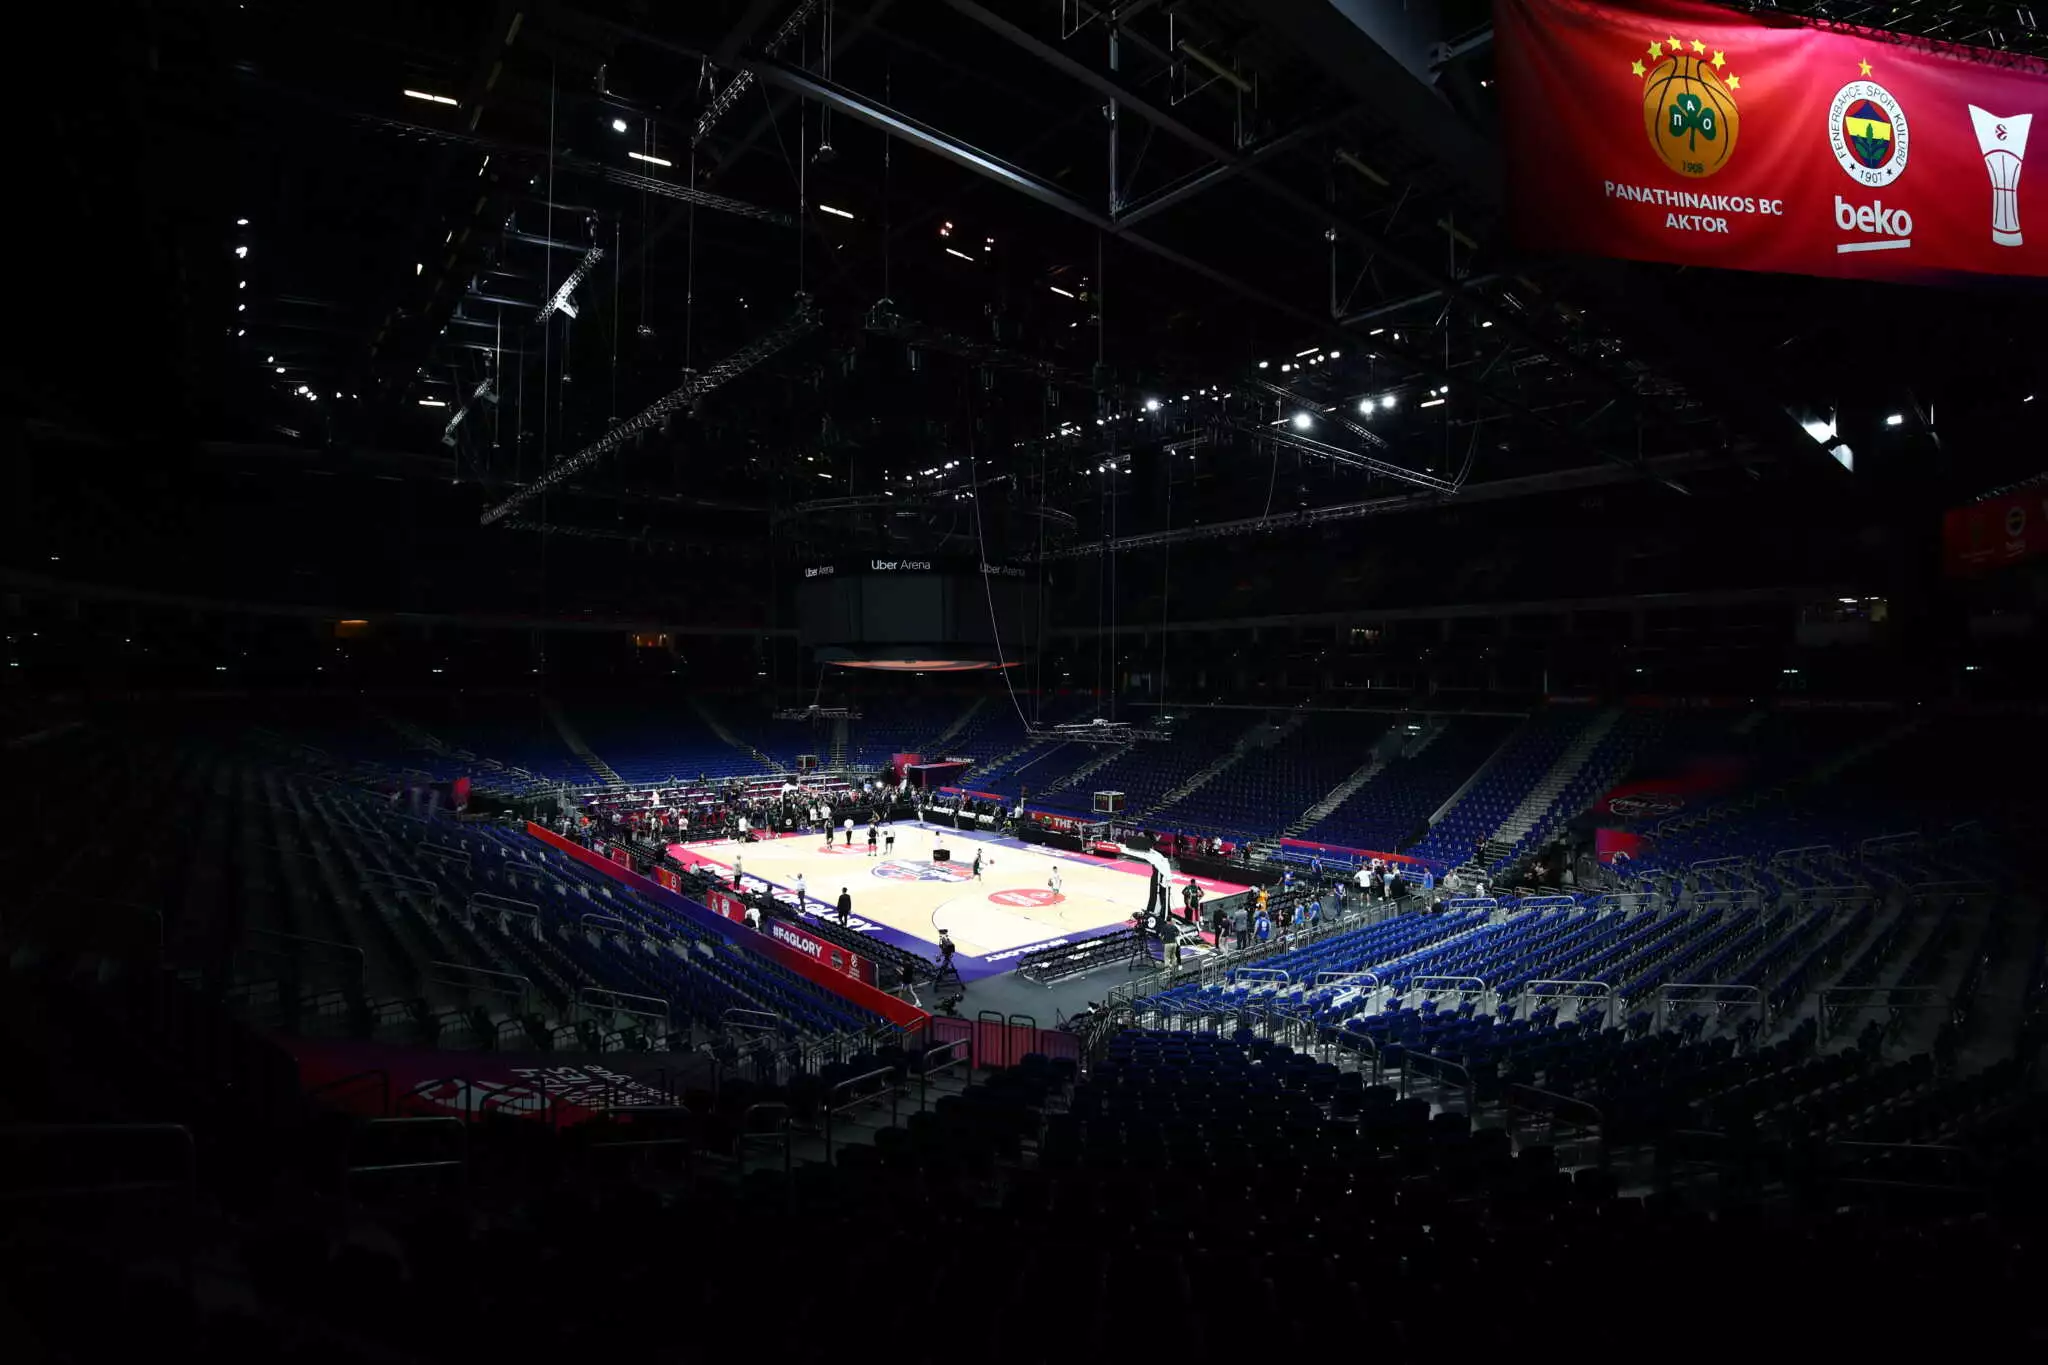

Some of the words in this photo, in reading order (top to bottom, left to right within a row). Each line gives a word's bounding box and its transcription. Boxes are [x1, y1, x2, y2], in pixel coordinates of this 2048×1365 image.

[1866, 85, 1895, 112] SPOR
[1860, 169, 1882, 184] 1907
[1604, 180, 1755, 213] PANATHINAIKOS
[1759, 198, 1783, 215] BC
[1666, 212, 1729, 233] AKTOR
[1835, 195, 1912, 236] beko
[871, 559, 898, 570] Uber
[900, 559, 931, 570] Arena
[773, 924, 823, 958] #F4GLORY
